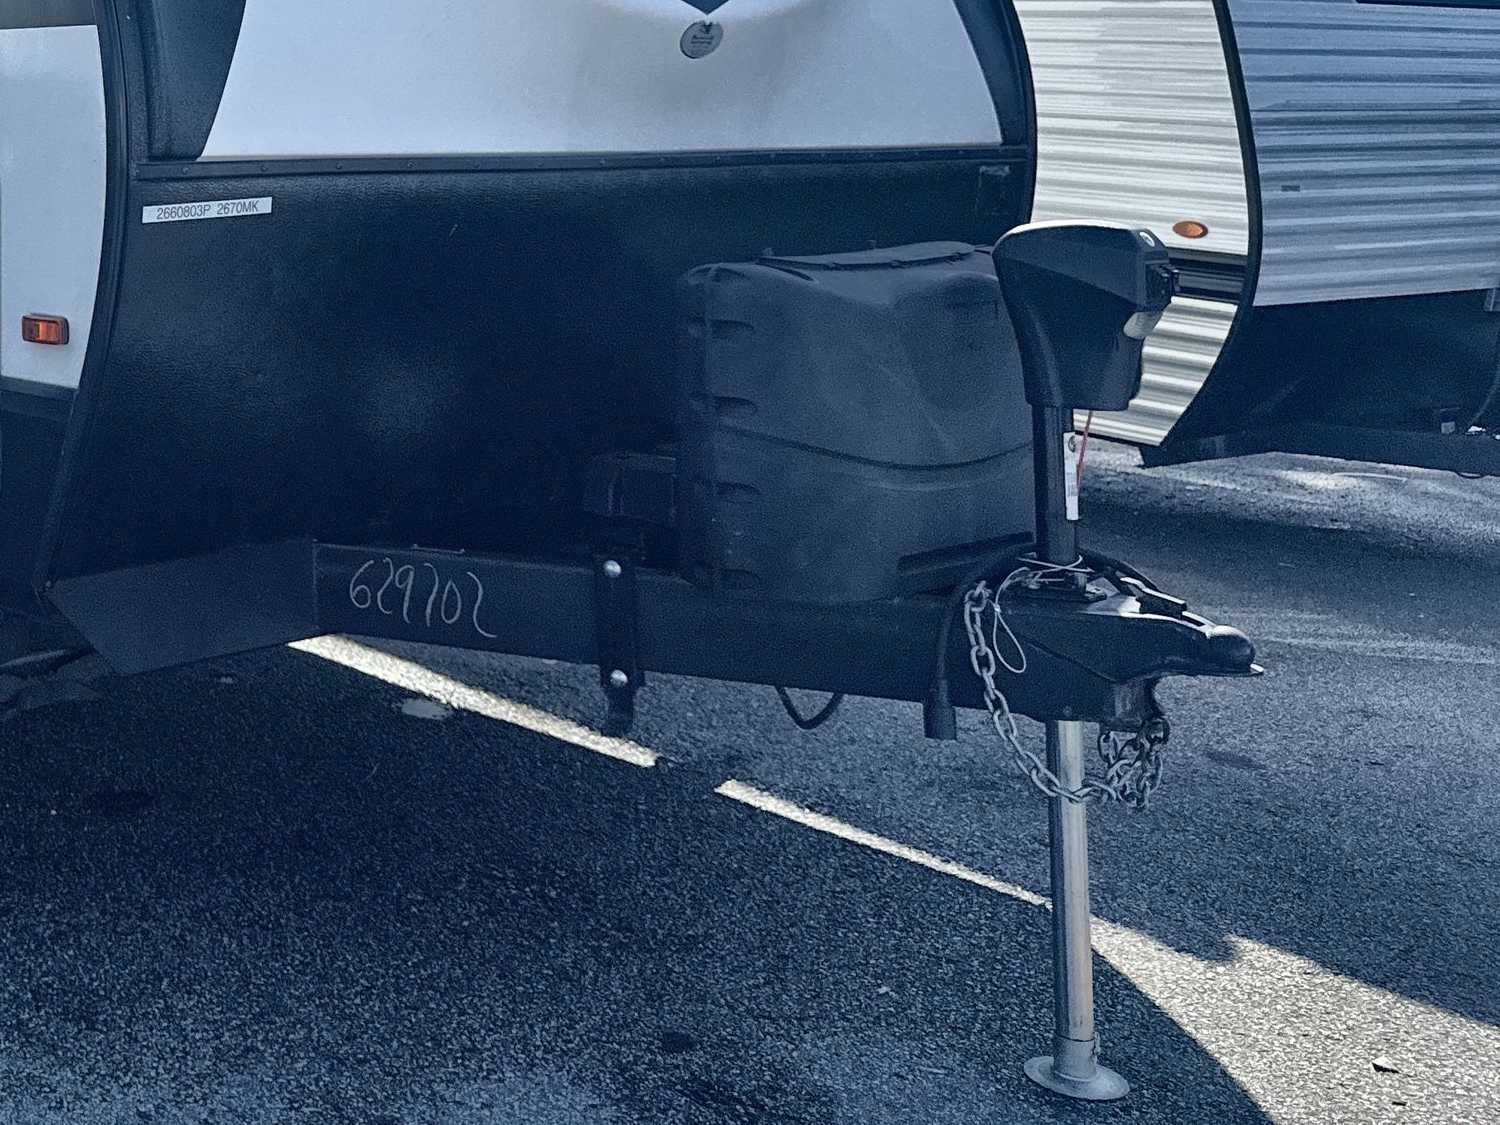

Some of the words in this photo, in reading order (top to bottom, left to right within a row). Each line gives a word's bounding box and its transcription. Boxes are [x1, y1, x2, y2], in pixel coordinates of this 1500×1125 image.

[156, 205, 211, 221] 2660803P
[216, 200, 259, 216] 2670MK
[350, 558, 498, 638] 629702
